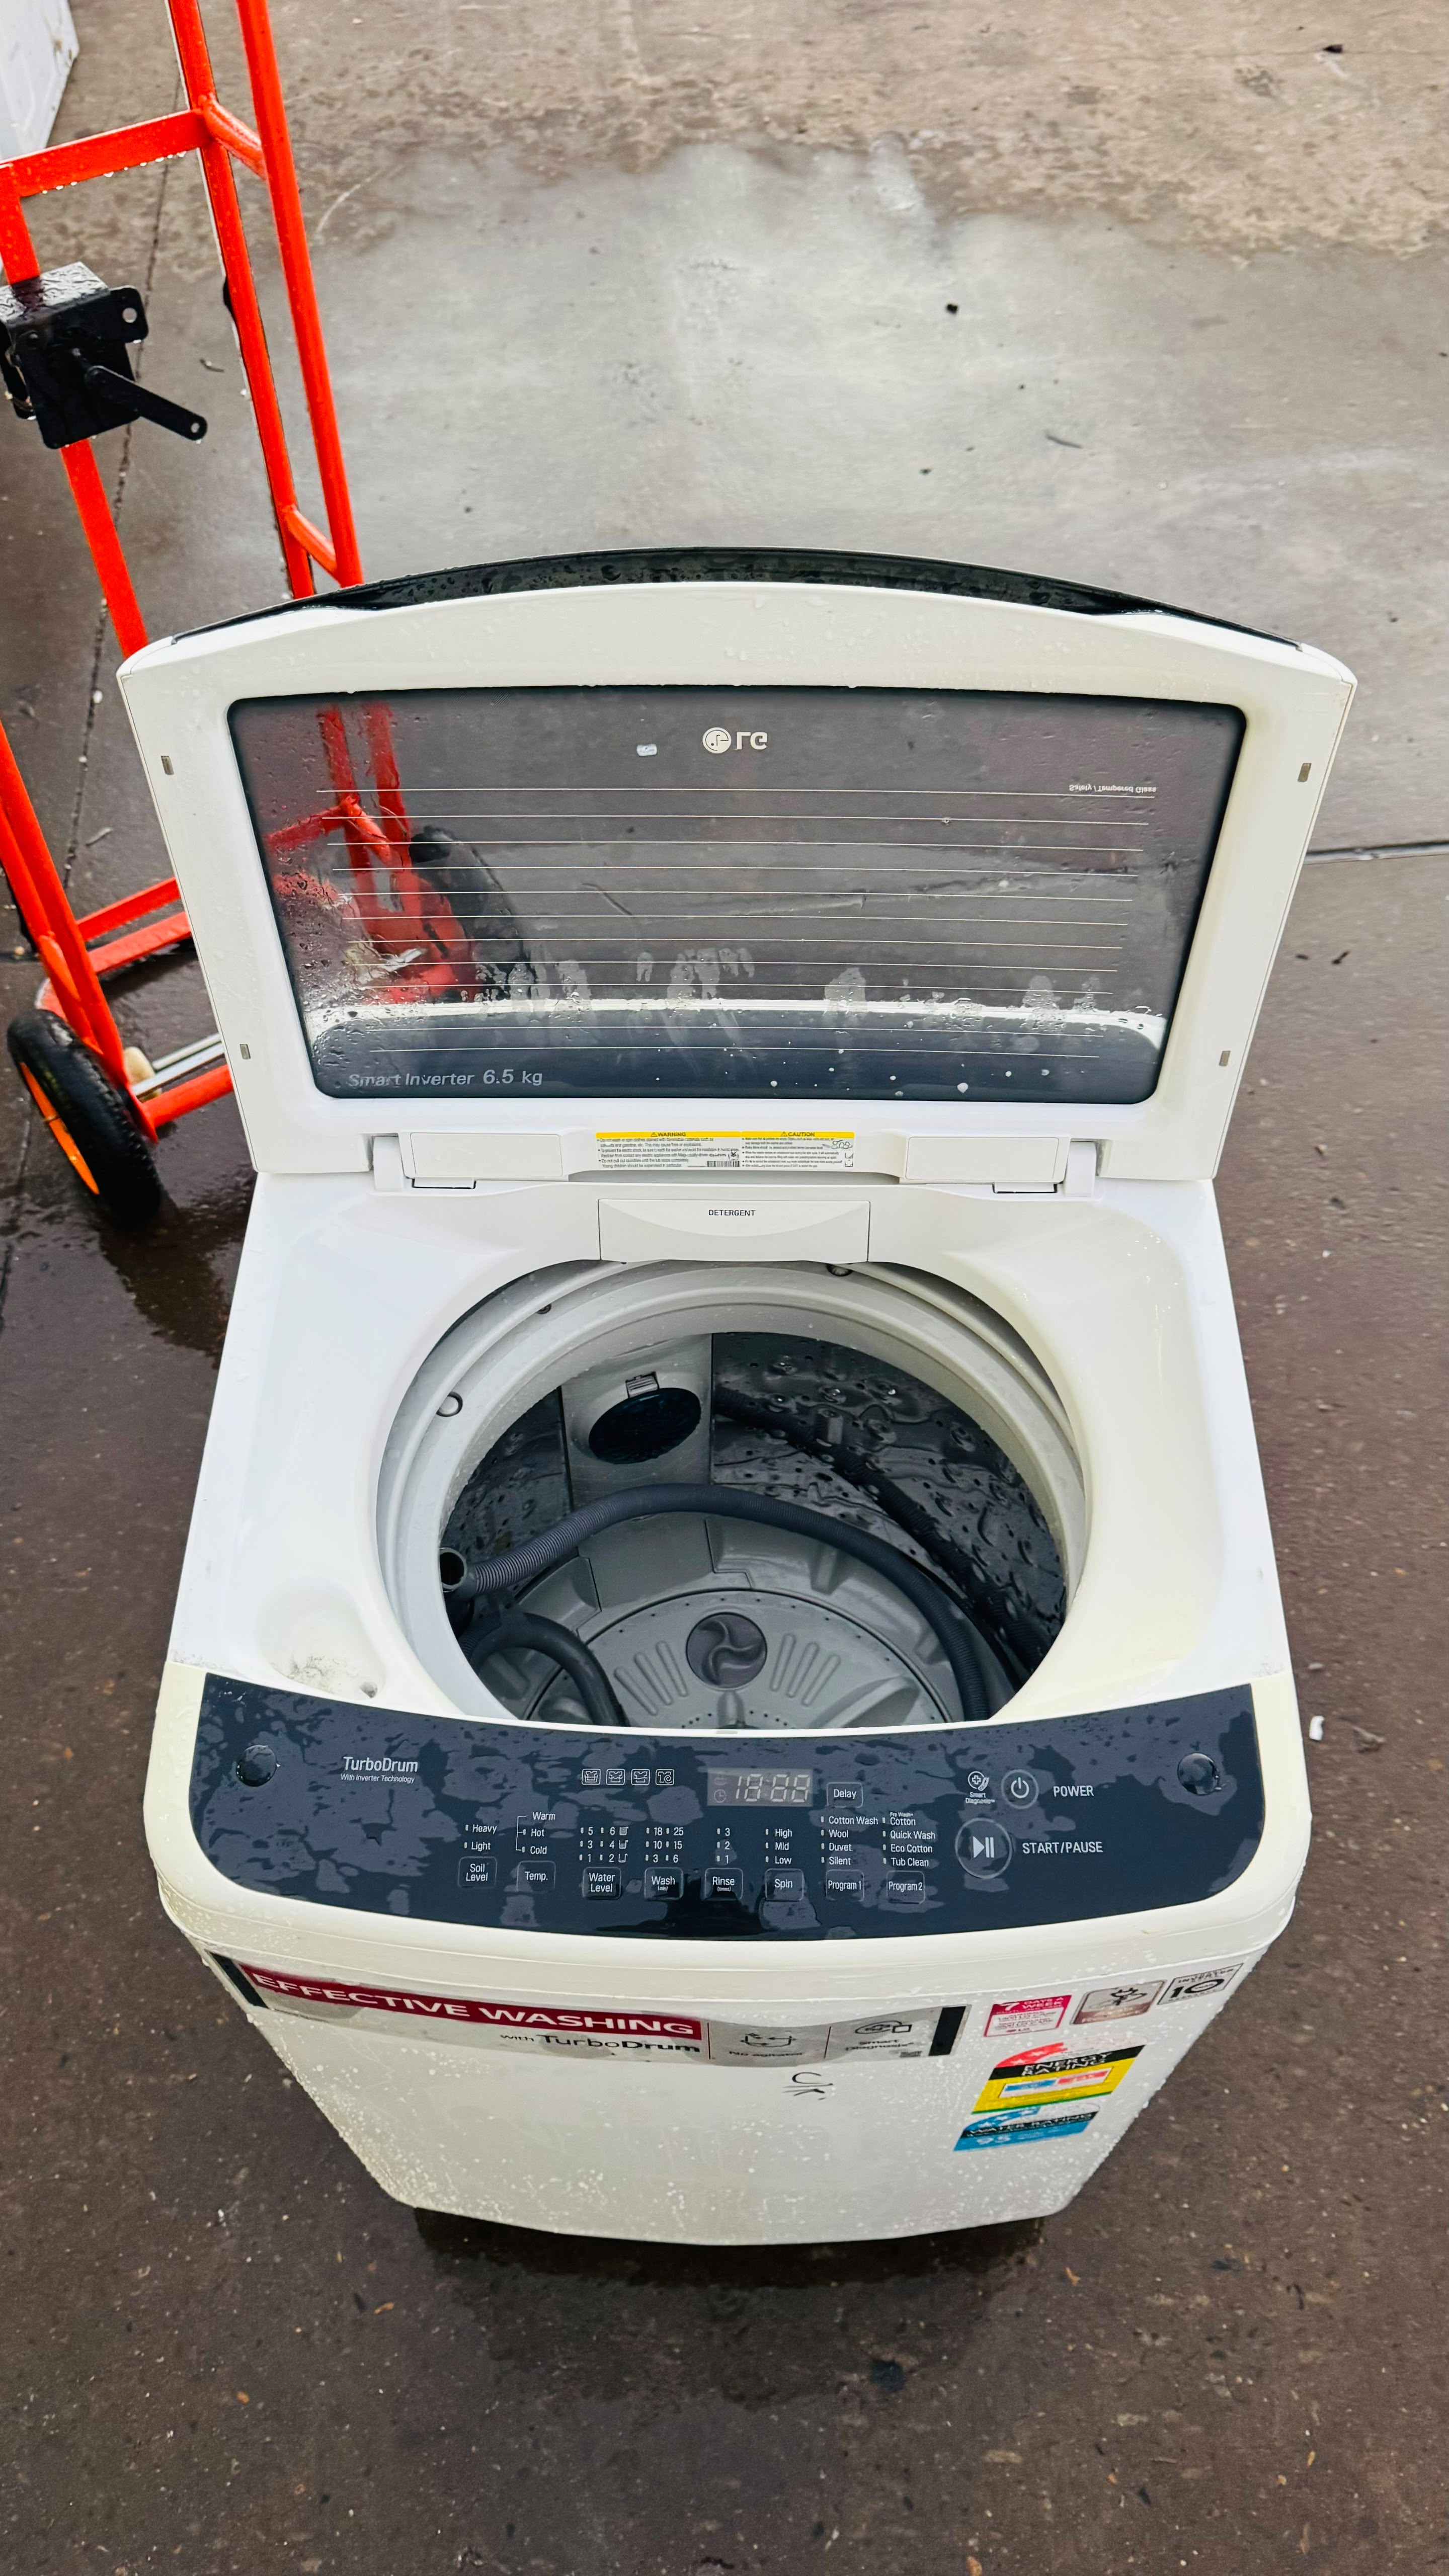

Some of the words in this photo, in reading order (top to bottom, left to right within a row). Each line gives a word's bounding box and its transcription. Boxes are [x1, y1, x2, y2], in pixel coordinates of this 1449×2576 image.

[348, 1074, 401, 1087] Smart
[406, 1073, 474, 1085] Inverter
[483, 1069, 514, 1084] 6.5
[522, 1071, 542, 1086] kg
[343, 1756, 418, 1772] TurboDrum
[381, 1775, 415, 1784] Technology
[834, 1789, 856, 1799] Delay
[1053, 1786, 1094, 1797] POWER
[532, 1812, 555, 1820] Warm
[829, 1816, 854, 1824] Cotton
[856, 1816, 878, 1825] Wash
[890, 1817, 916, 1825] Cotton
[472, 1824, 497, 1834] Heavy
[531, 1828, 544, 1837] Hot
[588, 1827, 593, 1835] 5
[610, 1827, 615, 1835] 6
[654, 1827, 663, 1835] 18
[674, 1827, 684, 1836] 25
[725, 1828, 730, 1836] 3
[775, 1828, 792, 1838] High
[829, 1829, 848, 1838] Wool
[890, 1830, 911, 1839] Quick
[914, 1831, 935, 1839] Wash
[471, 1842, 491, 1852] Light
[588, 1840, 593, 1848] 3
[609, 1840, 614, 1848] 4
[653, 1840, 662, 1849] 10
[674, 1840, 682, 1849] 15
[725, 1841, 730, 1849] 2
[775, 1842, 789, 1850] Mid
[829, 1842, 852, 1852] Duvet
[891, 1844, 905, 1853] Eco
[907, 1844, 933, 1853] Cotton
[1022, 1841, 1103, 1854] START/PAUSE
[530, 1846, 547, 1855] Cold
[587, 1854, 591, 1862] 1
[609, 1854, 614, 1862] 2
[653, 1854, 658, 1863] 3
[673, 1855, 678, 1863] 6
[725, 1855, 729, 1864] 1
[775, 1856, 792, 1864] Low
[829, 1857, 851, 1865] Silent
[891, 1858, 905, 1866] Tub
[907, 1858, 929, 1866] Clean
[470, 1864, 485, 1873] Soil
[466, 1873, 488, 1882] Level
[525, 1871, 548, 1882] Temp.
[589, 1873, 615, 1882] Water
[652, 1876, 675, 1885] Wash
[712, 1876, 735, 1885] Rinse
[591, 1883, 613, 1892] Level
[775, 1879, 792, 1890] Spin
[828, 1880, 857, 1891] Program
[858, 1881, 861, 1890] 1
[889, 1881, 917, 1892] Program
[918, 1882, 922, 1891] 2
[1170, 1979, 1225, 1998] 10
[253, 1973, 470, 2017] EFFECTIVE
[479, 2008, 694, 2035] WASHING
[536, 2034, 700, 2052] TurboDrum
